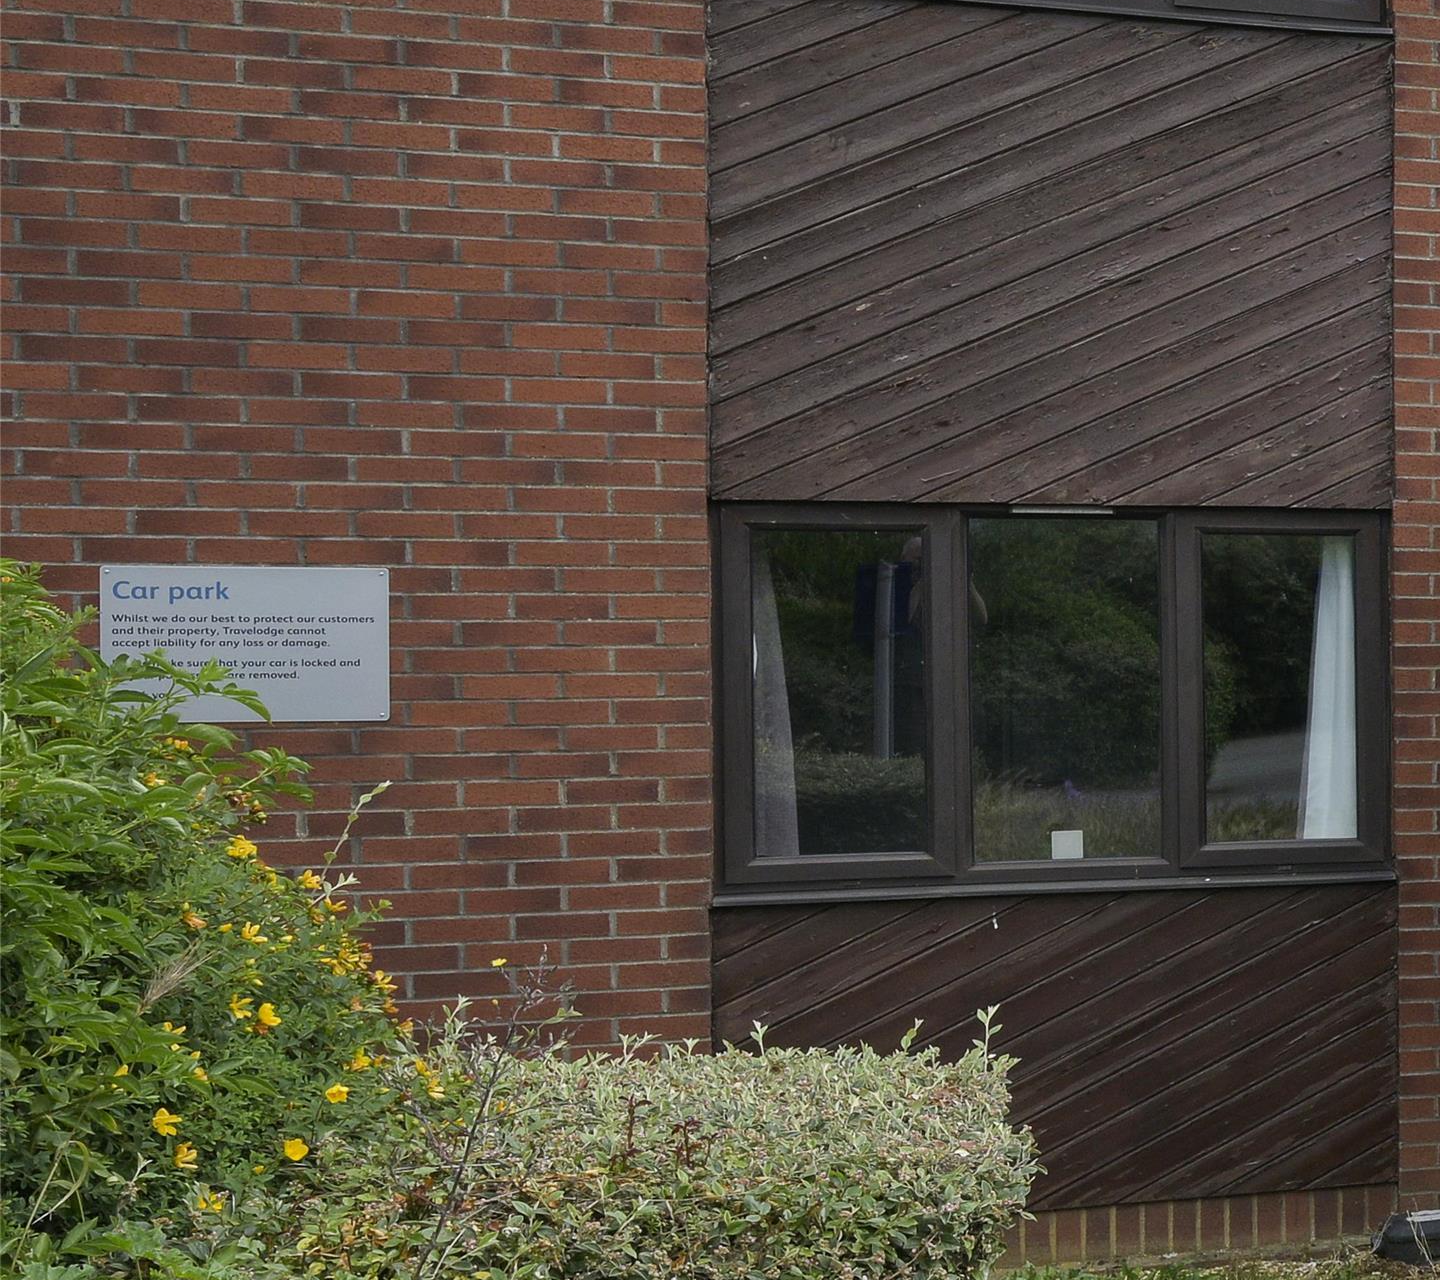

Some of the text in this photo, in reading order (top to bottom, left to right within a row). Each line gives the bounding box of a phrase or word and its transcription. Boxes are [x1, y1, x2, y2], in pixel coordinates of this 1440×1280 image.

[112, 580, 229, 605] Car park
[112, 614, 148, 623] Whilst
[171, 614, 186, 623] do
[211, 614, 237, 623] best
[238, 615, 251, 623] to
[253, 615, 294, 625] protect
[318, 615, 375, 623] customers
[112, 626, 327, 637] and their property, Travelodge cannot
[112, 639, 150, 649] accept
[153, 638, 197, 649] liability
[199, 638, 216, 647] for
[219, 640, 240, 649] any
[243, 638, 264, 647] loss
[281, 639, 330, 649] damage.
[218, 659, 239, 667] hat
[241, 659, 266, 669] your
[289, 659, 298, 667] is
[301, 658, 336, 667] locked
[339, 658, 361, 667] and
[248, 670, 300, 679] removed.
